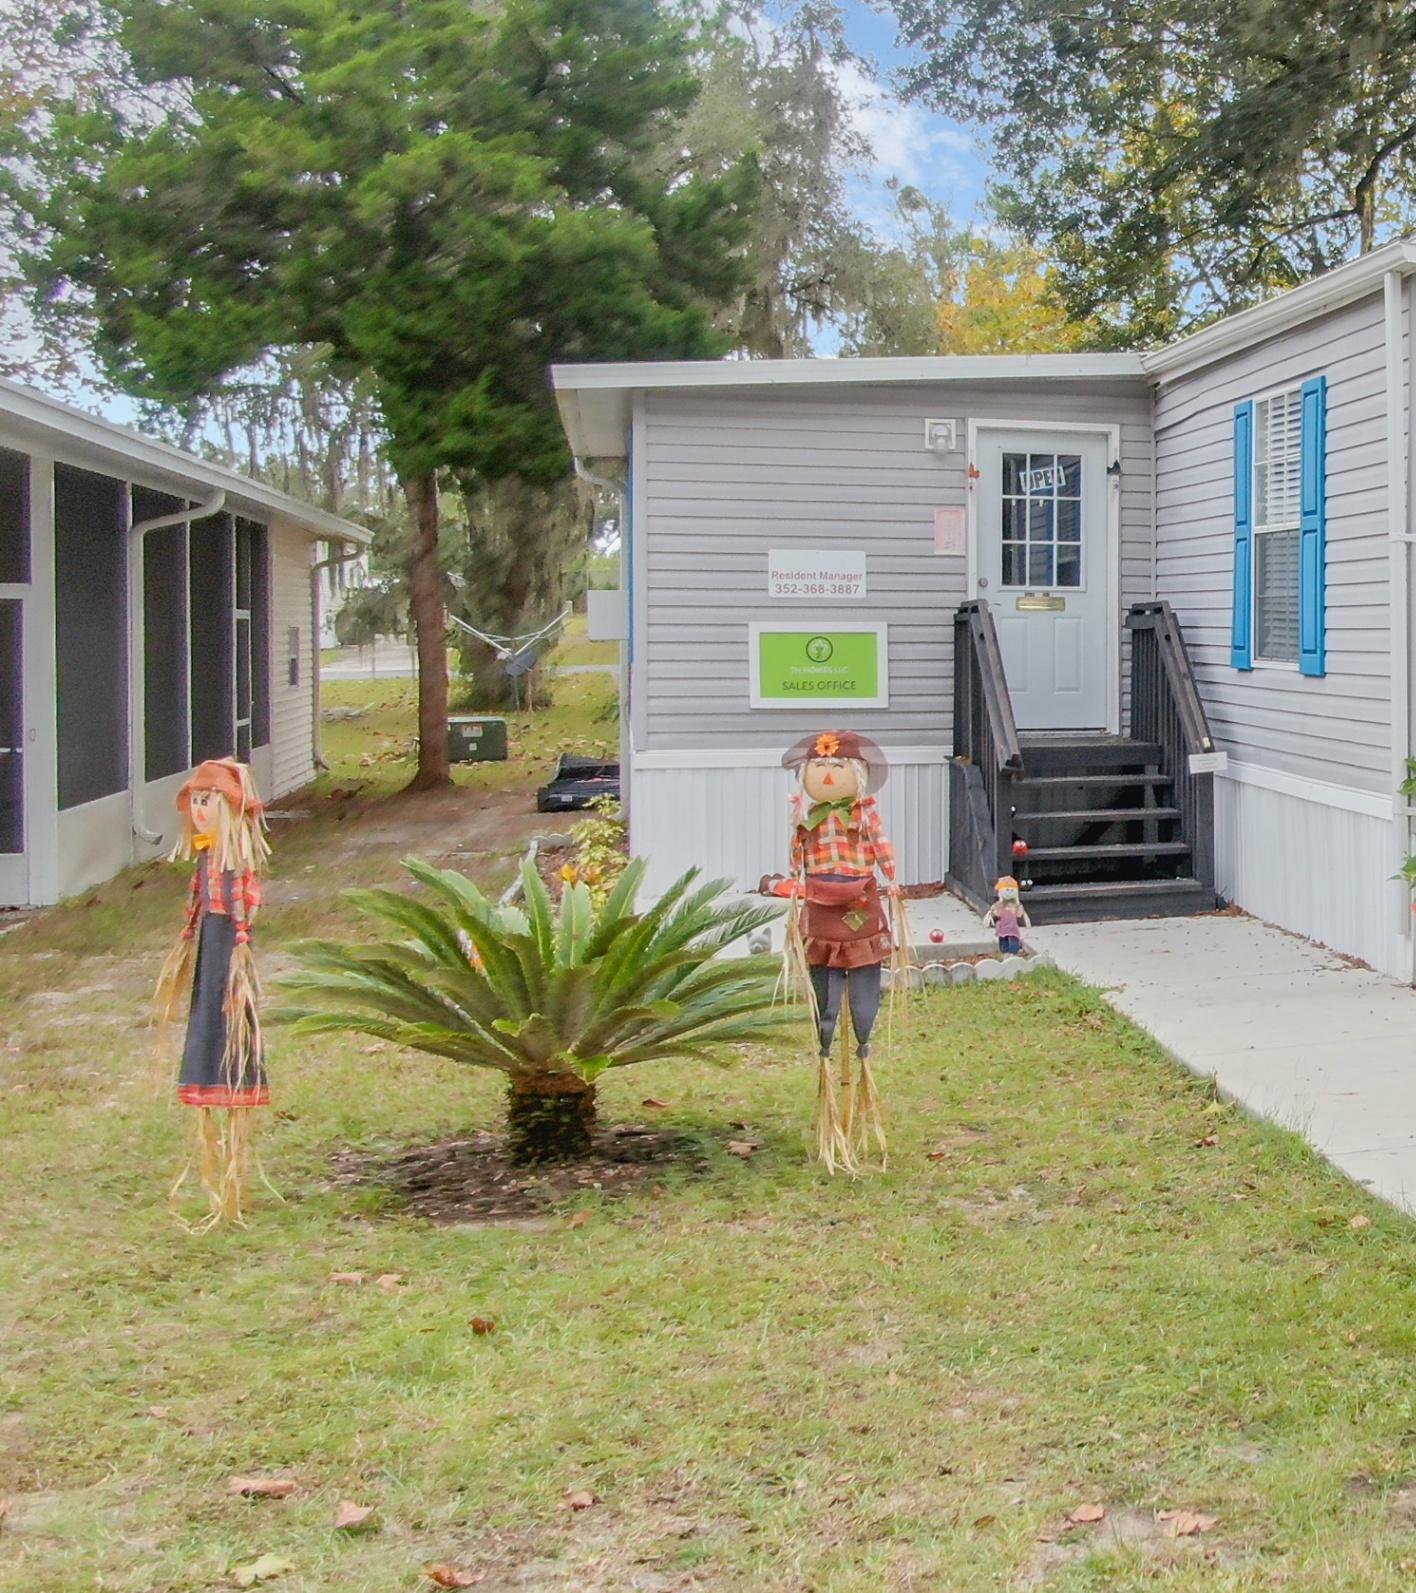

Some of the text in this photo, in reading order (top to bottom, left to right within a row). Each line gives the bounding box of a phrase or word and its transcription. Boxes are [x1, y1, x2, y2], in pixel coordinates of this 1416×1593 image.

[771, 571, 863, 583] Resident Manager
[775, 583, 860, 595] 352-368-3887
[781, 680, 857, 691] SALES OFFICE
